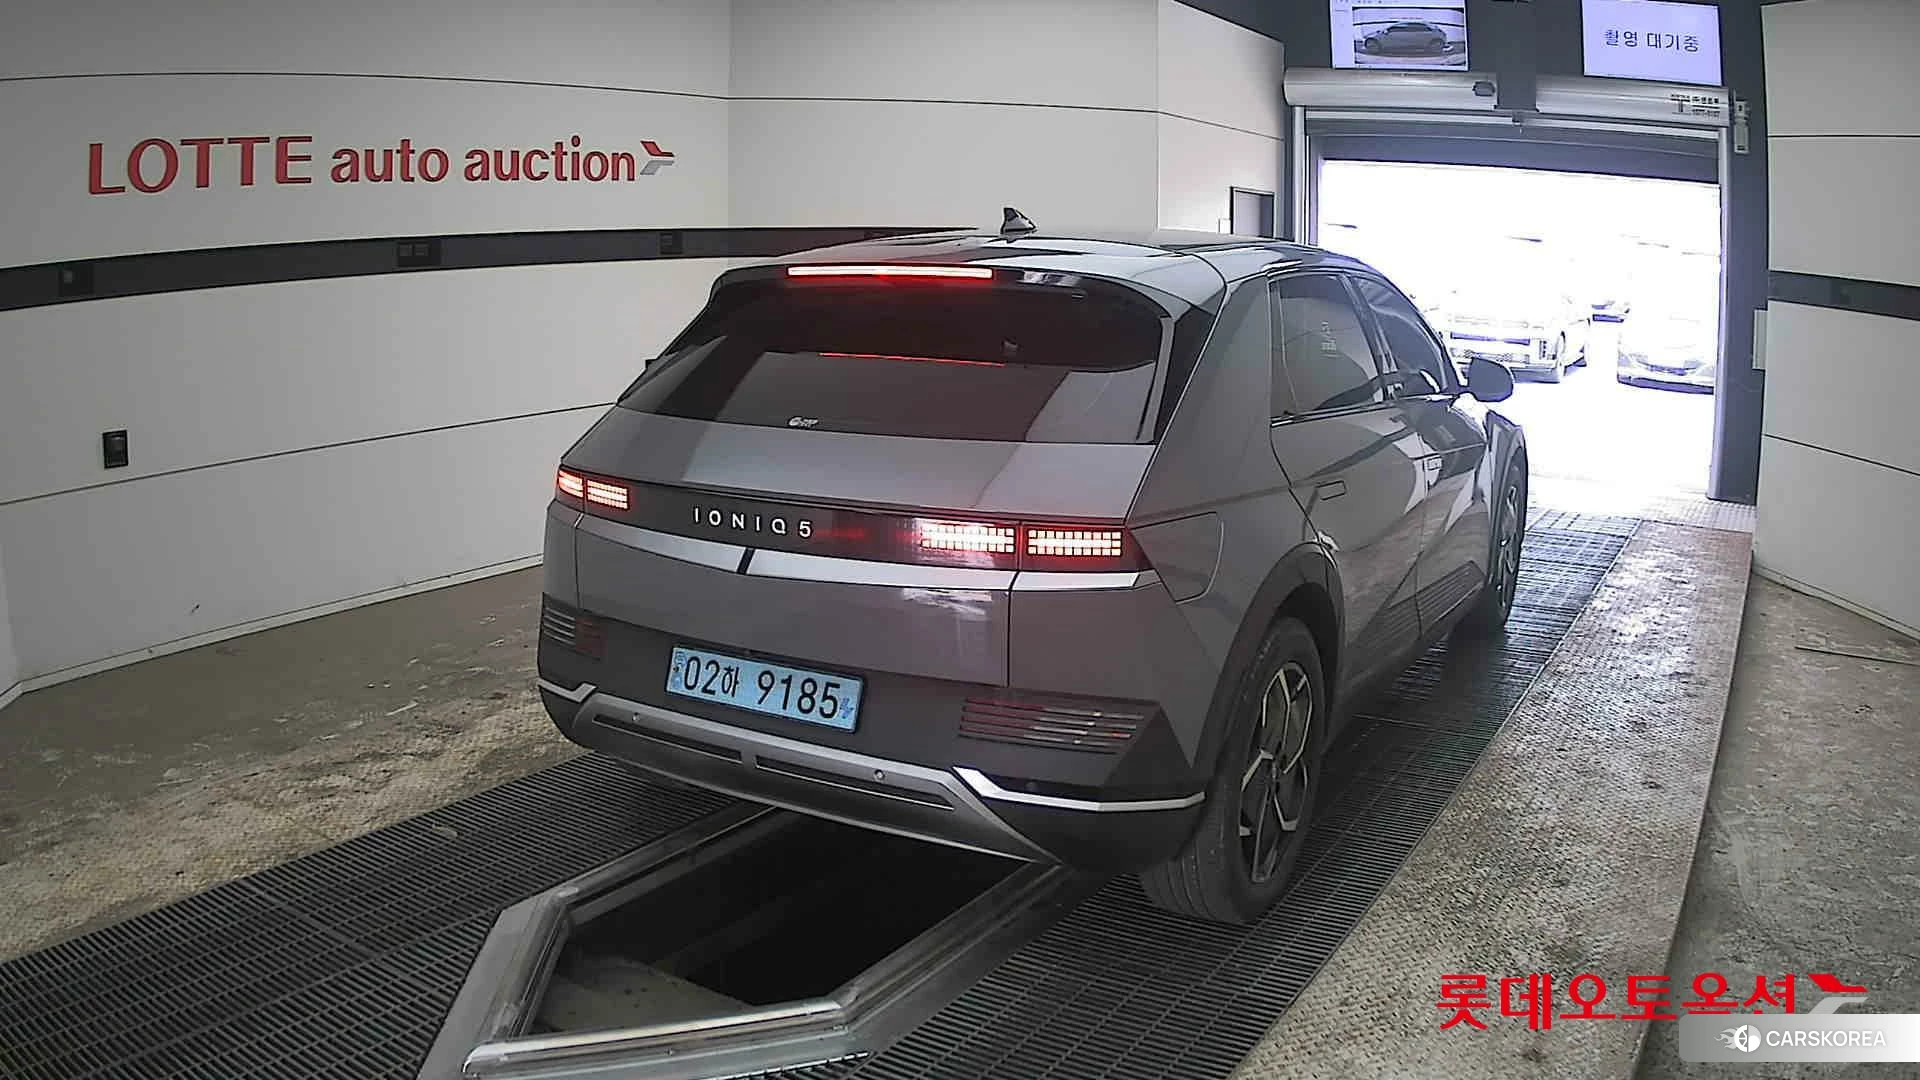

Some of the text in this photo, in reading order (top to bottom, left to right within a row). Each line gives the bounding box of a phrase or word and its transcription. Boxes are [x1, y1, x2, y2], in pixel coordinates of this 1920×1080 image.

[1646, 32, 1699, 53] 대기중
[88, 135, 636, 195] LOTTE auto auction
[694, 507, 812, 538] IONIQ 5
[684, 656, 841, 719] 02하 9185
